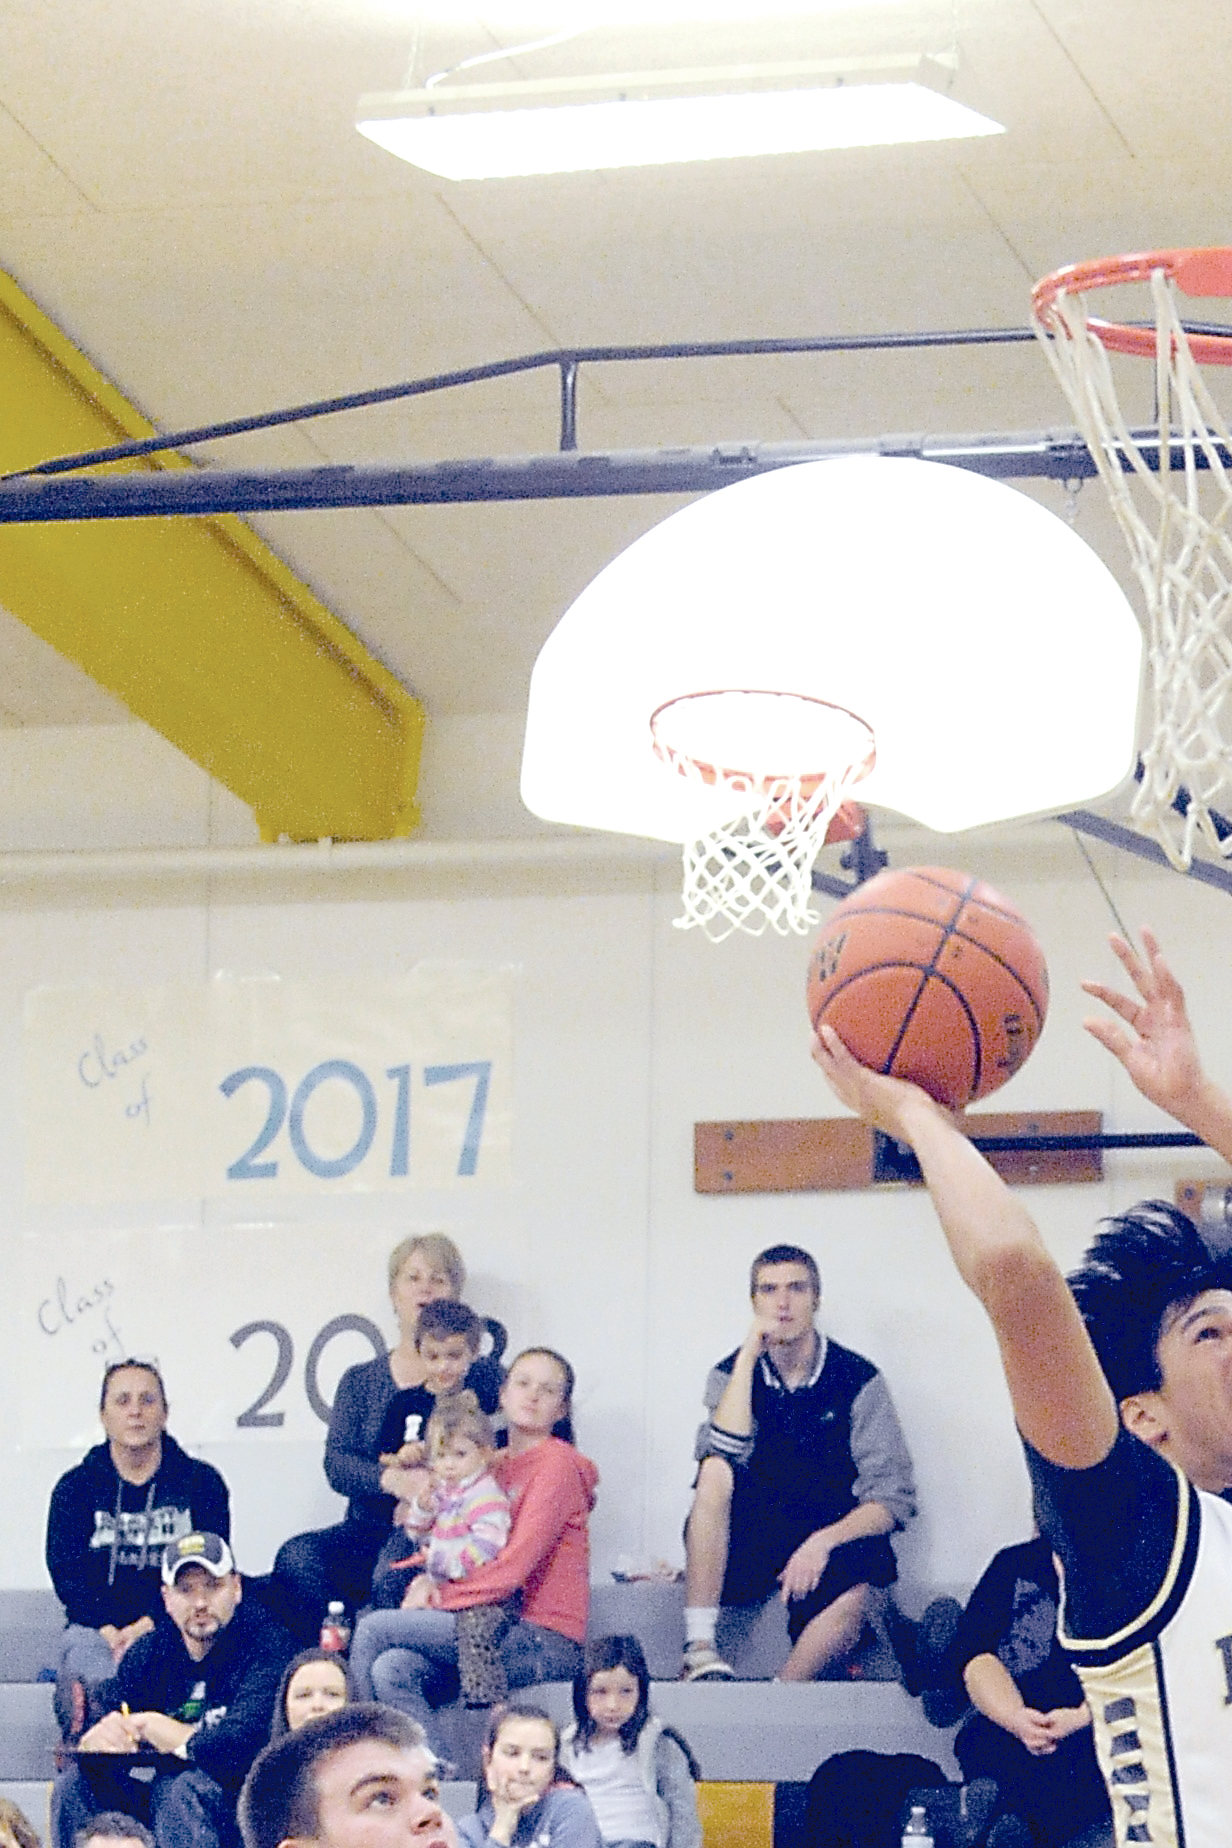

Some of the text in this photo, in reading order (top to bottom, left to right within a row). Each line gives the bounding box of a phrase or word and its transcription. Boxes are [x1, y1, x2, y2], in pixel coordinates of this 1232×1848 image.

[77, 1031, 150, 1089] Class
[125, 1072, 152, 1127] of
[218, 1058, 493, 1180] 2017
[37, 1276, 115, 1336] Class
